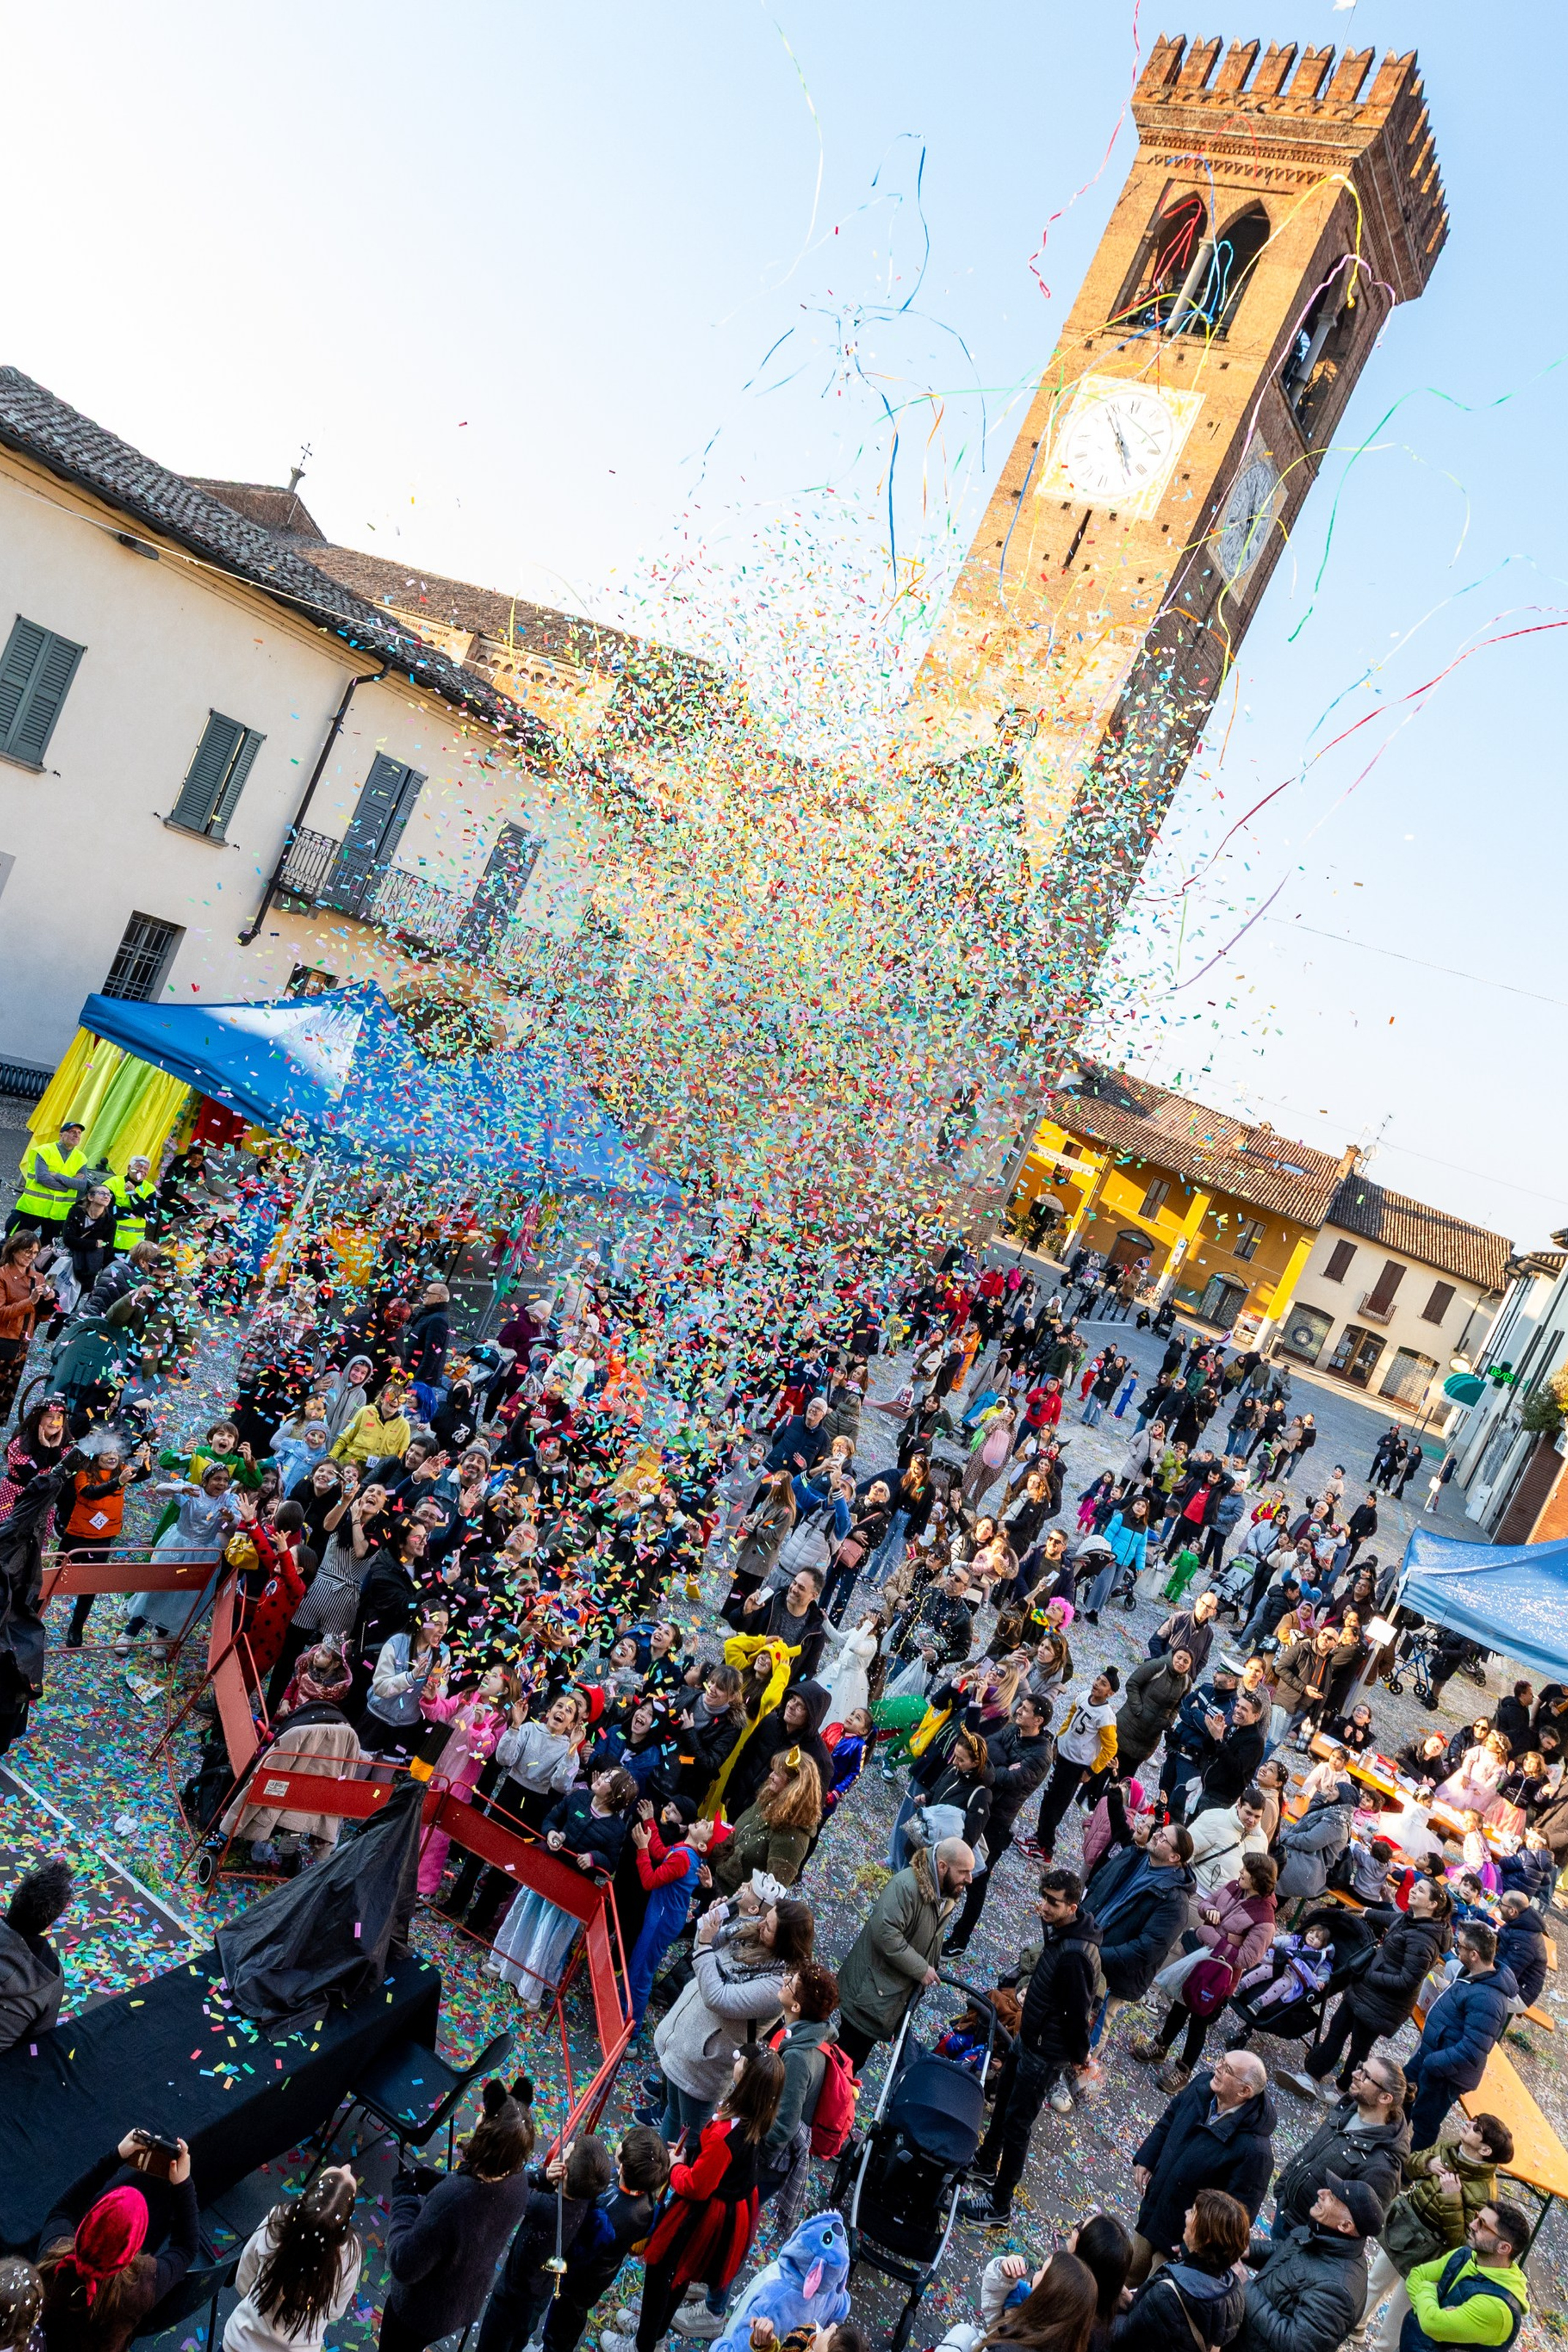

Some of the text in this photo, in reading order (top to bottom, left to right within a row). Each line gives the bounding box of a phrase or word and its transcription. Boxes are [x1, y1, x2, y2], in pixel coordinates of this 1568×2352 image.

[1490, 1367, 1515, 1384] 02/03
[93, 1517, 105, 1526] 15
[1071, 1705, 1092, 1735] 75
